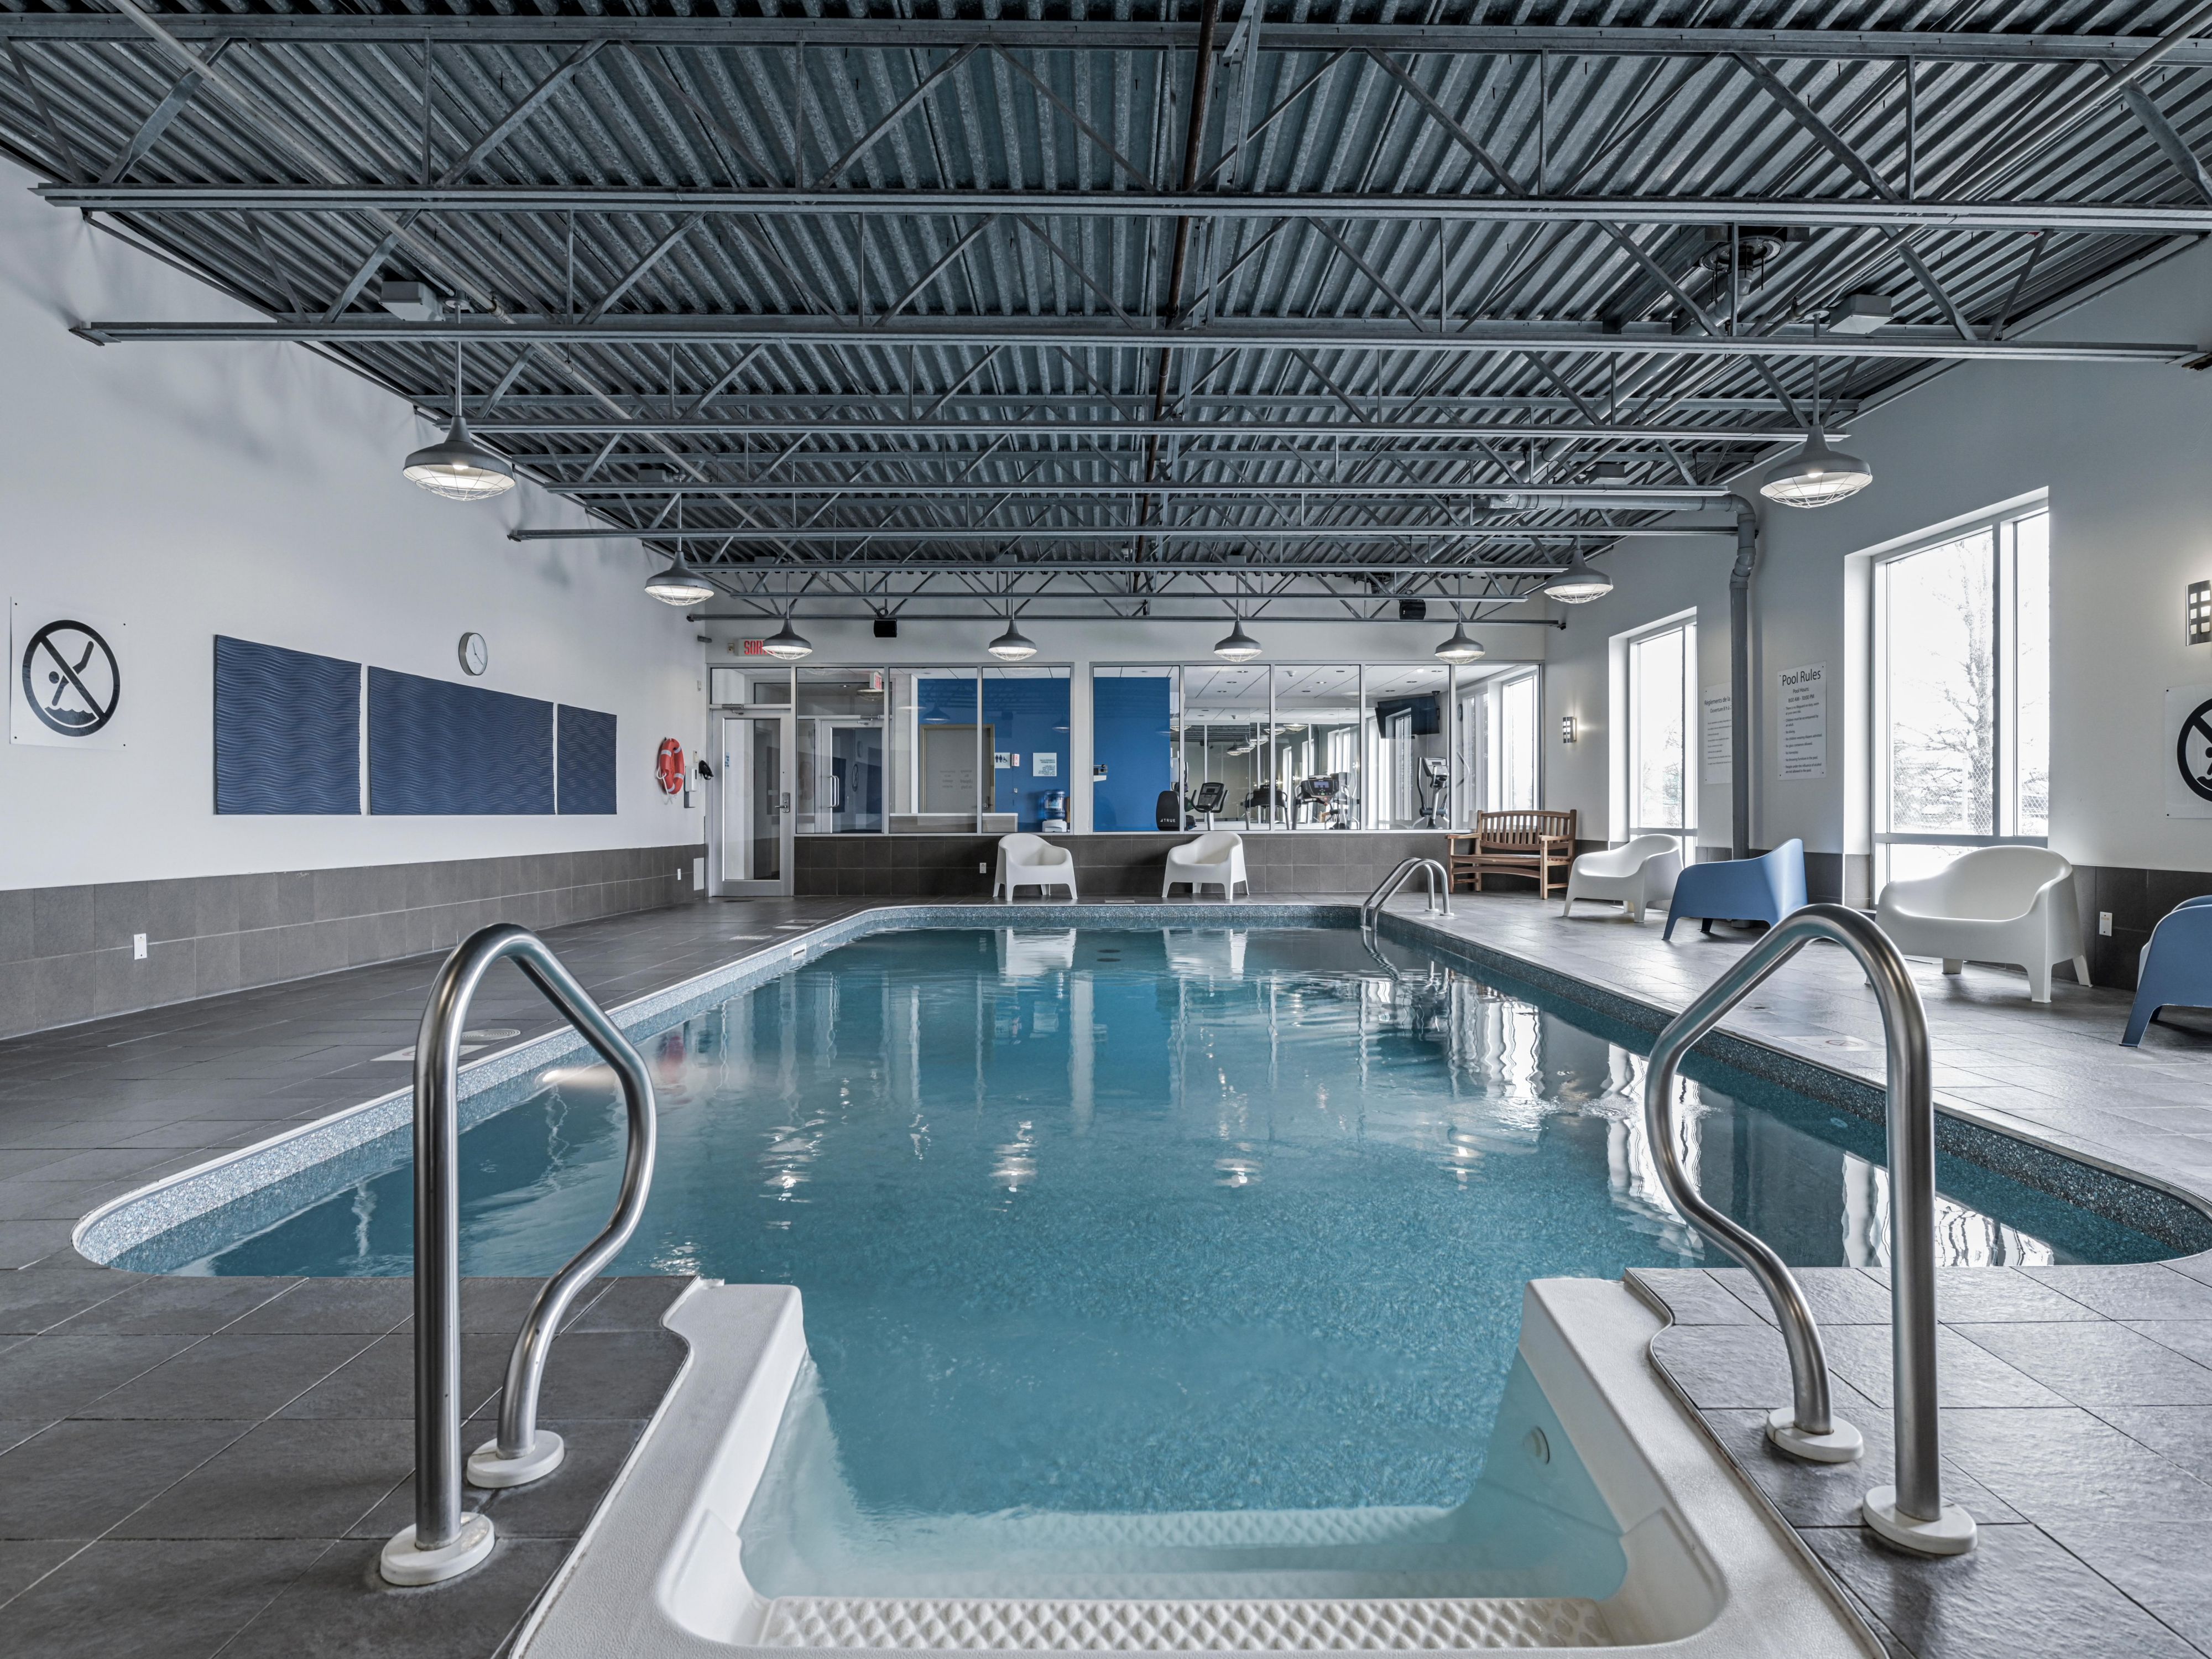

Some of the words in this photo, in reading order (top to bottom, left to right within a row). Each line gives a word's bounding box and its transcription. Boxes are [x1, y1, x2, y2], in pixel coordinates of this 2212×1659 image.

[744, 640, 775, 655] SOR
[1782, 671, 1798, 686] Pool
[1801, 668, 1821, 682] Rules
